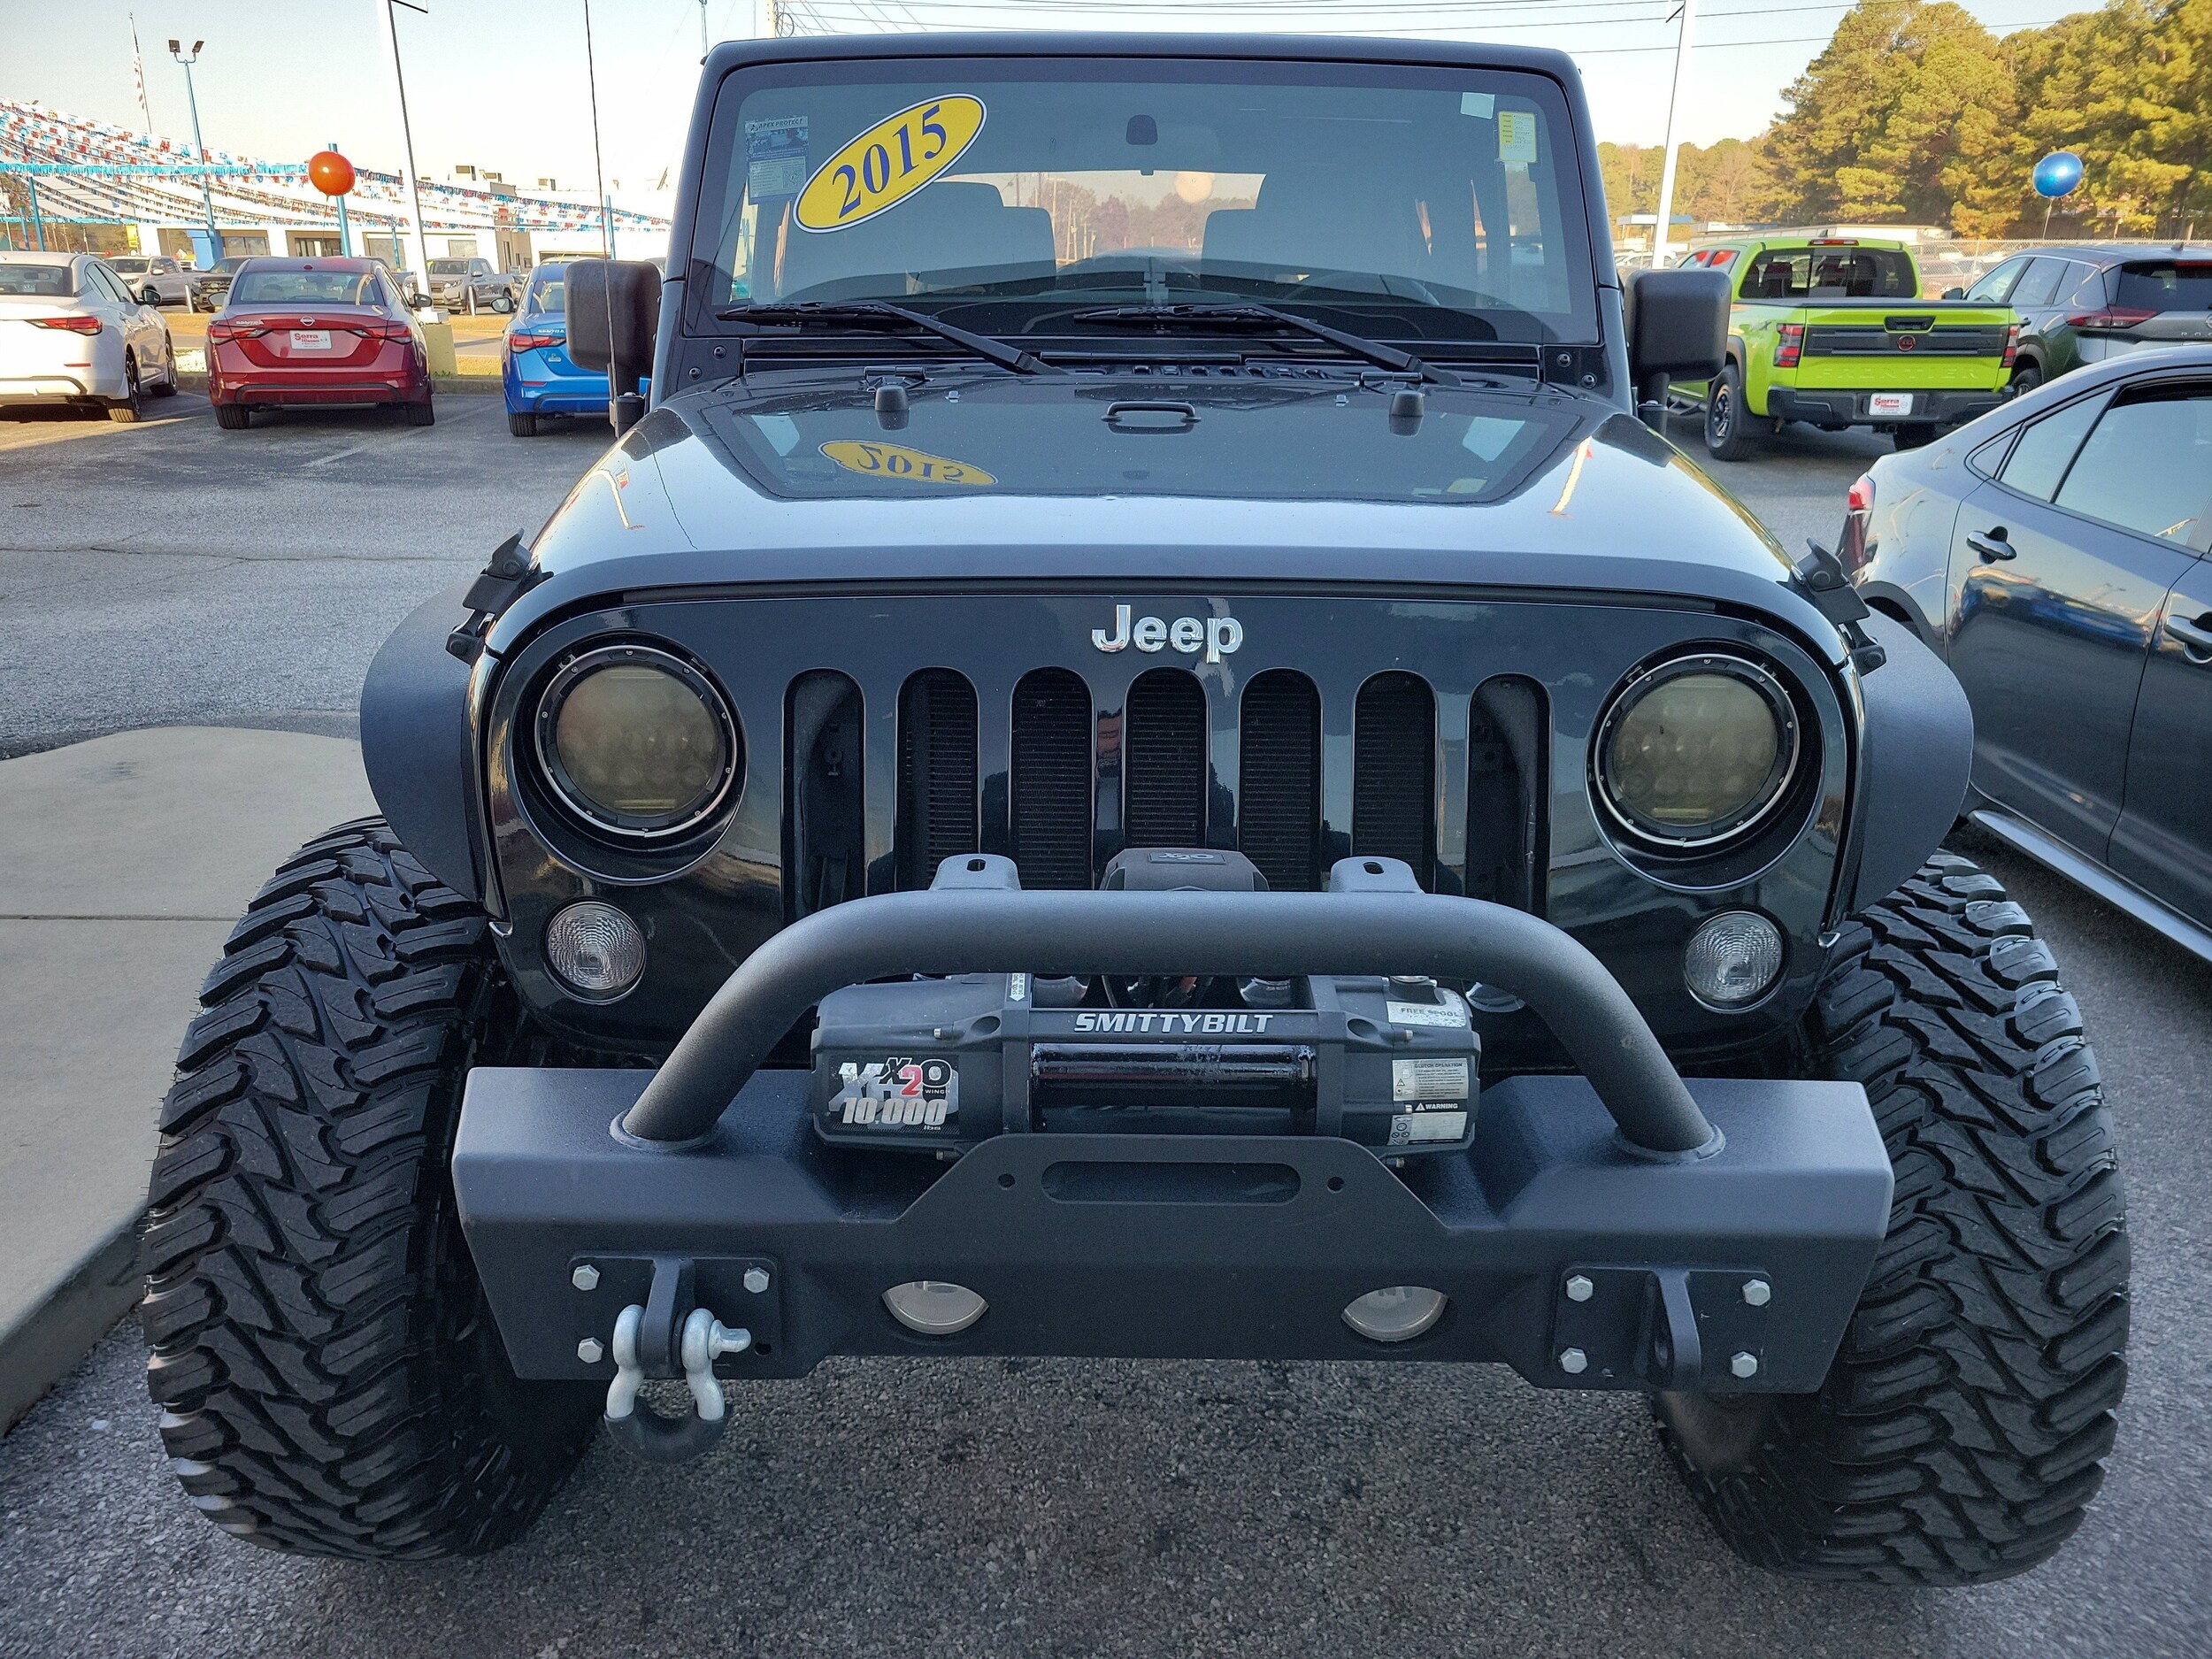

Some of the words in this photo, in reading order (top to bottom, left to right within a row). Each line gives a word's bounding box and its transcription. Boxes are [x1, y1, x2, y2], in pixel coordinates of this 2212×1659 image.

[832, 104, 947, 219] 2015
[1091, 603, 1244, 664] Jeep
[1073, 1012, 1274, 1033] SMITTYBILT
[841, 1096, 949, 1126] 10,000
